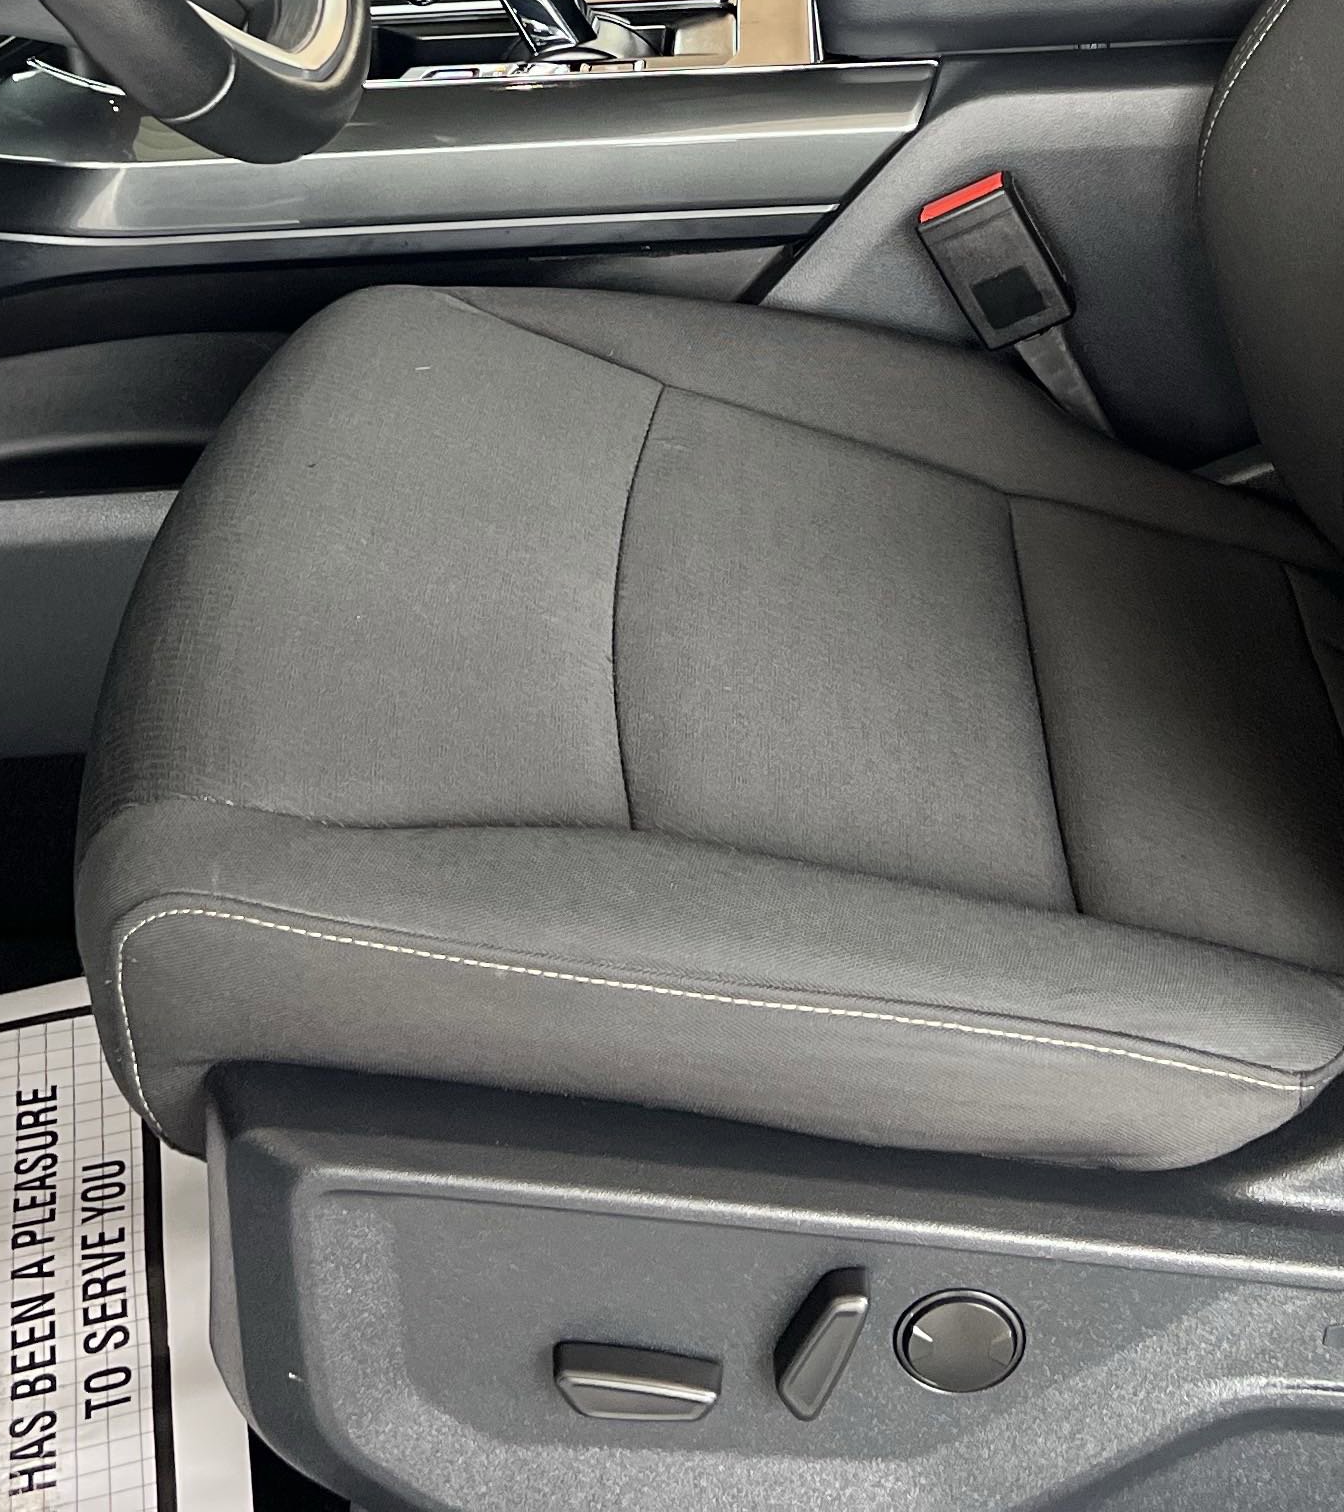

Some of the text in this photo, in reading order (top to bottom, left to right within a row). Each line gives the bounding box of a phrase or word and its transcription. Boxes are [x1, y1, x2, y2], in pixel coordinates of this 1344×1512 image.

[8, 1084, 59, 1497] HAS BEEN A PLEASURE
[80, 1159, 132, 1420] TO SERVE YOU
